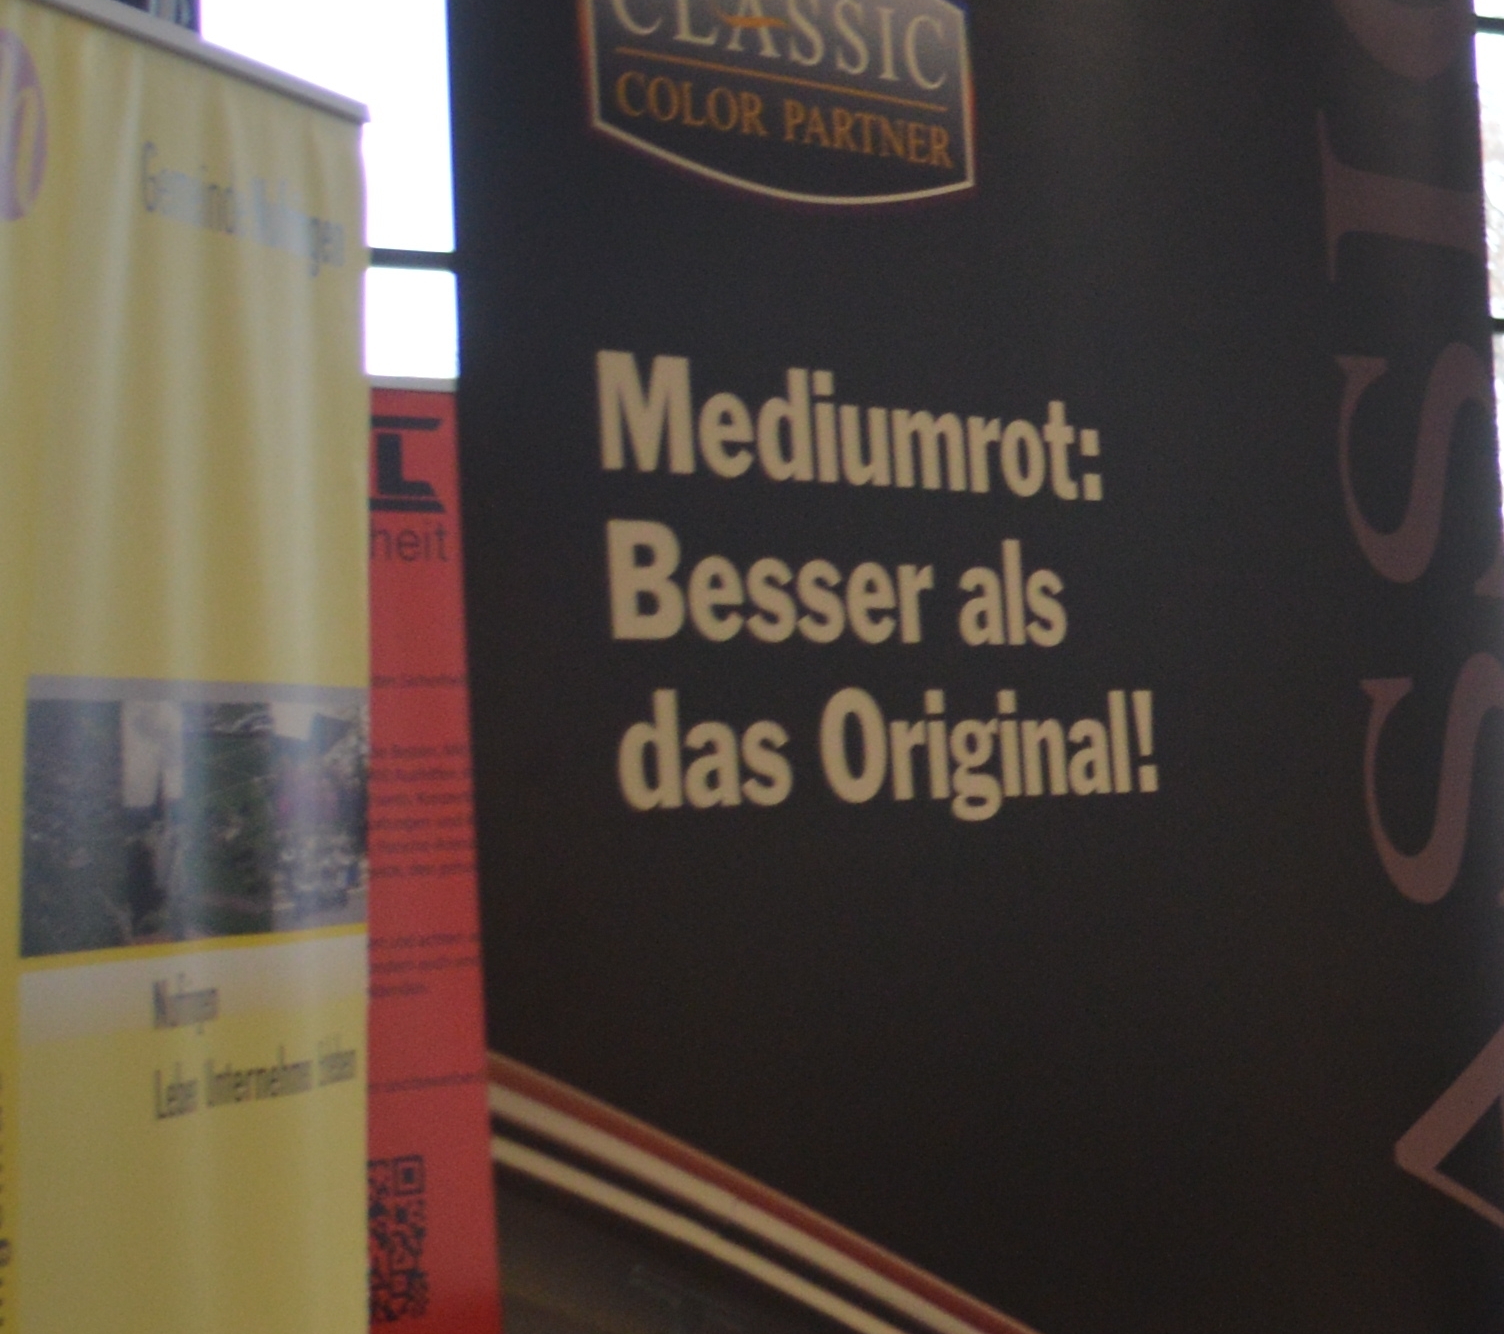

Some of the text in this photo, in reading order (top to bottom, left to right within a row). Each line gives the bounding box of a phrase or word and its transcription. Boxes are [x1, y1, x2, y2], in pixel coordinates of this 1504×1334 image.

[615, 70, 954, 169] COLOR PARTNER
[596, 349, 1102, 501] Mediumrot:
[606, 518, 1068, 647] Besser als
[618, 687, 1159, 821] das Original!
